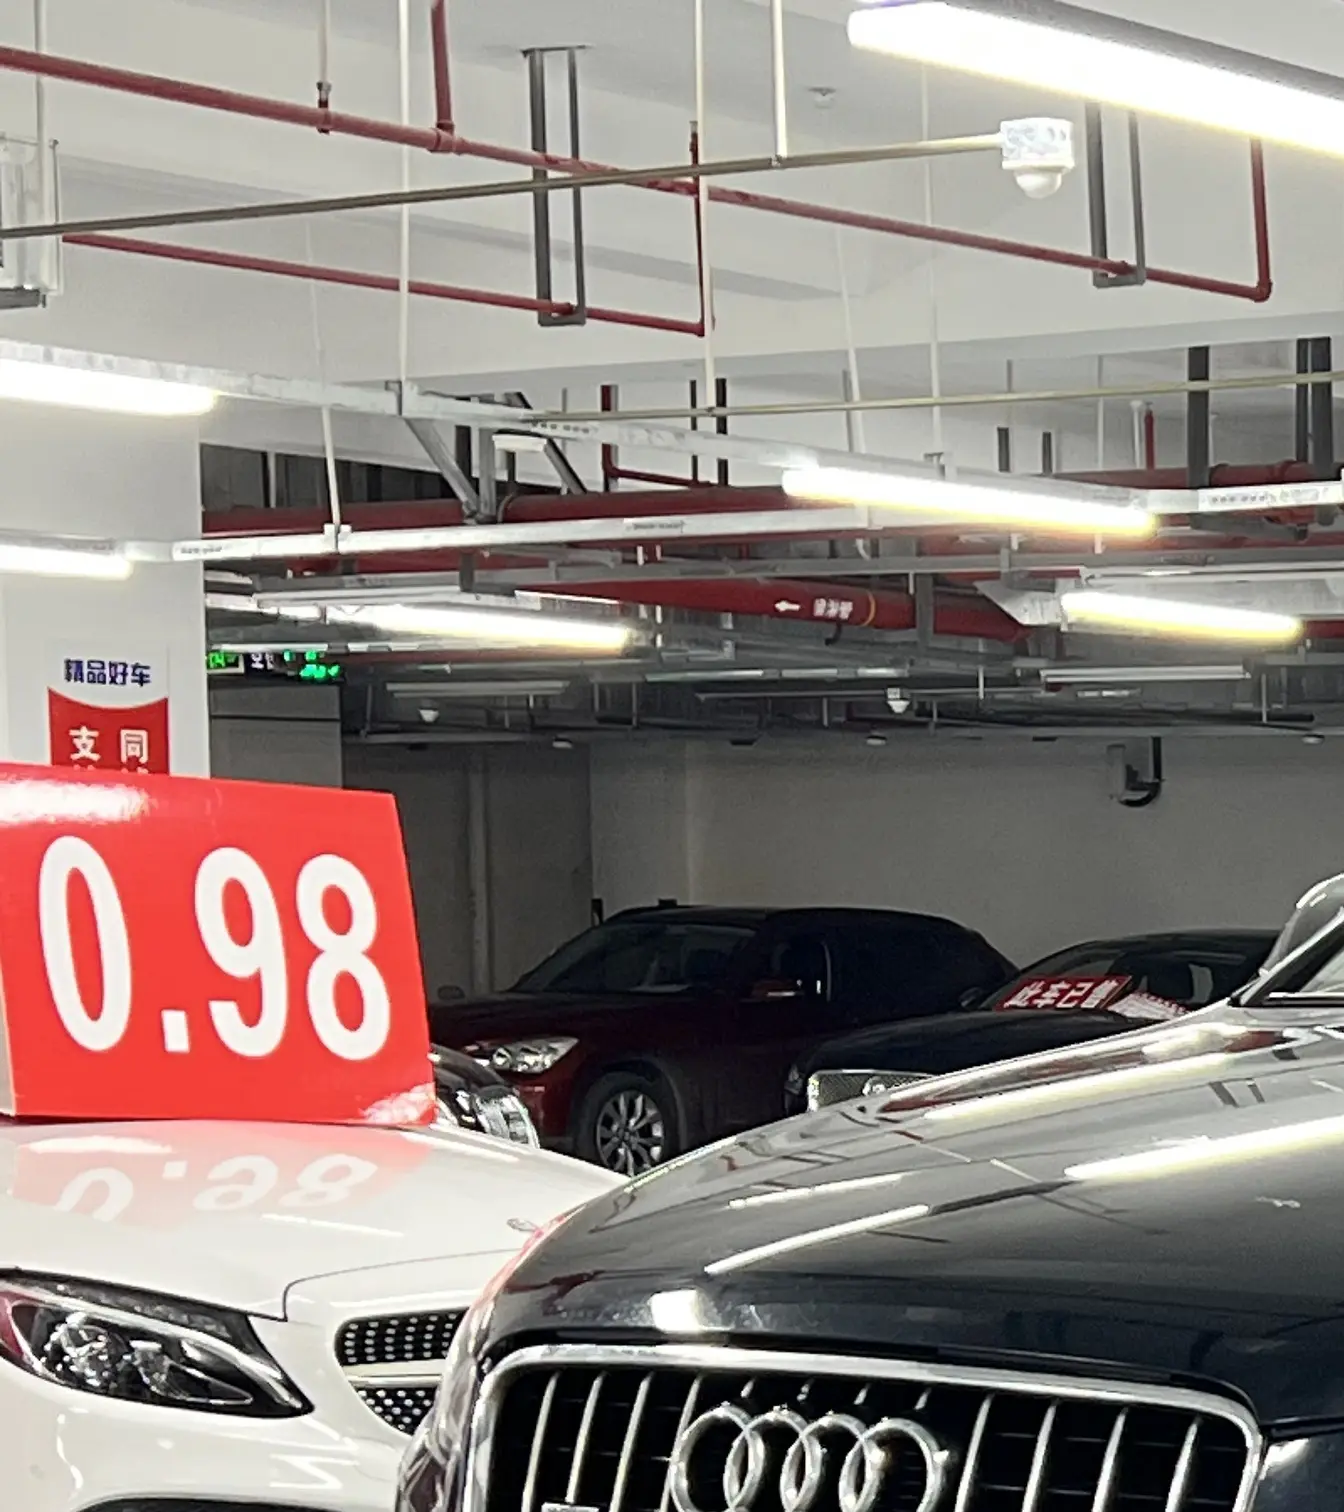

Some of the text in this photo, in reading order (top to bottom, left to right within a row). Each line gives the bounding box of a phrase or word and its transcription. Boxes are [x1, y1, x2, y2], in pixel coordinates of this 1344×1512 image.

[64, 659, 151, 687] 精品好车
[69, 726, 101, 770] 支
[119, 728, 149, 773] 同
[39, 835, 390, 1060] 0.98
